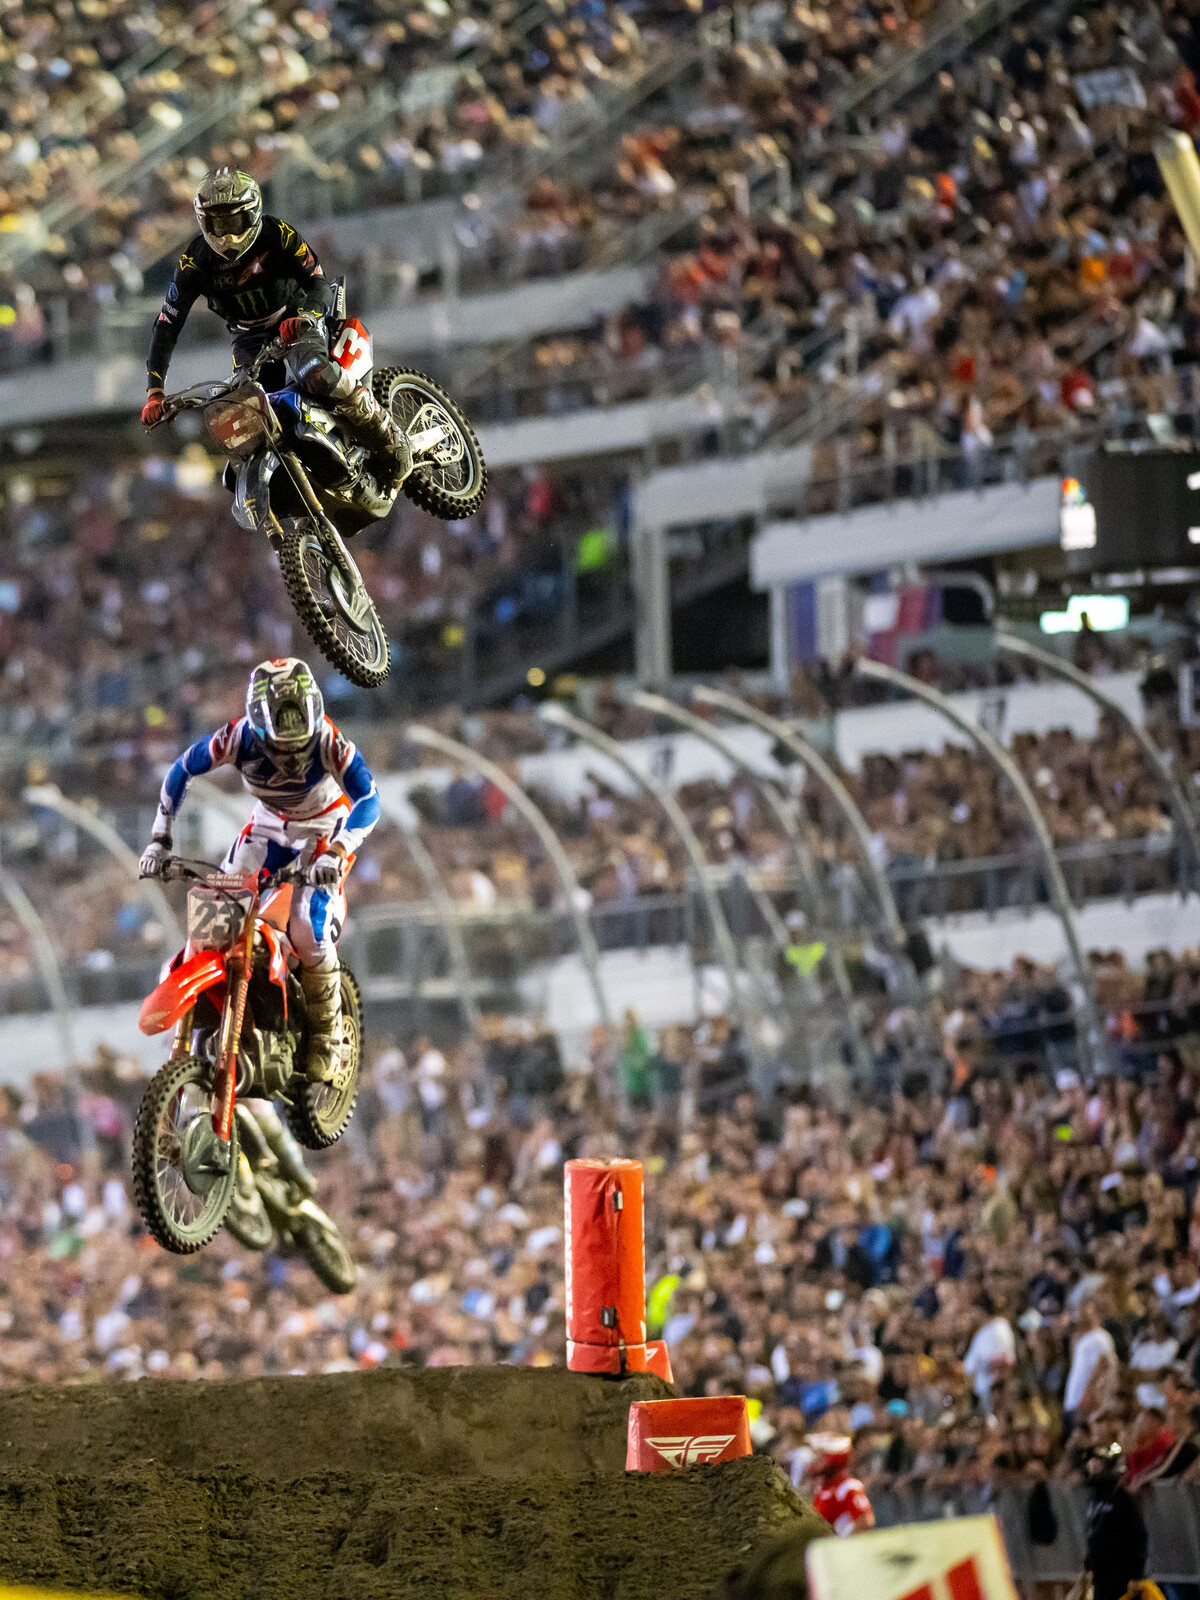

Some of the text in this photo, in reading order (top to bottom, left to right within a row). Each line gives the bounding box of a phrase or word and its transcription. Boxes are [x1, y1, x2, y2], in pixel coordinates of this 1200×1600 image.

[336, 285, 346, 314] DUNLOP
[333, 327, 375, 383] 3
[192, 902, 246, 941] 23
[221, 1073, 233, 1133] DUNLOP
